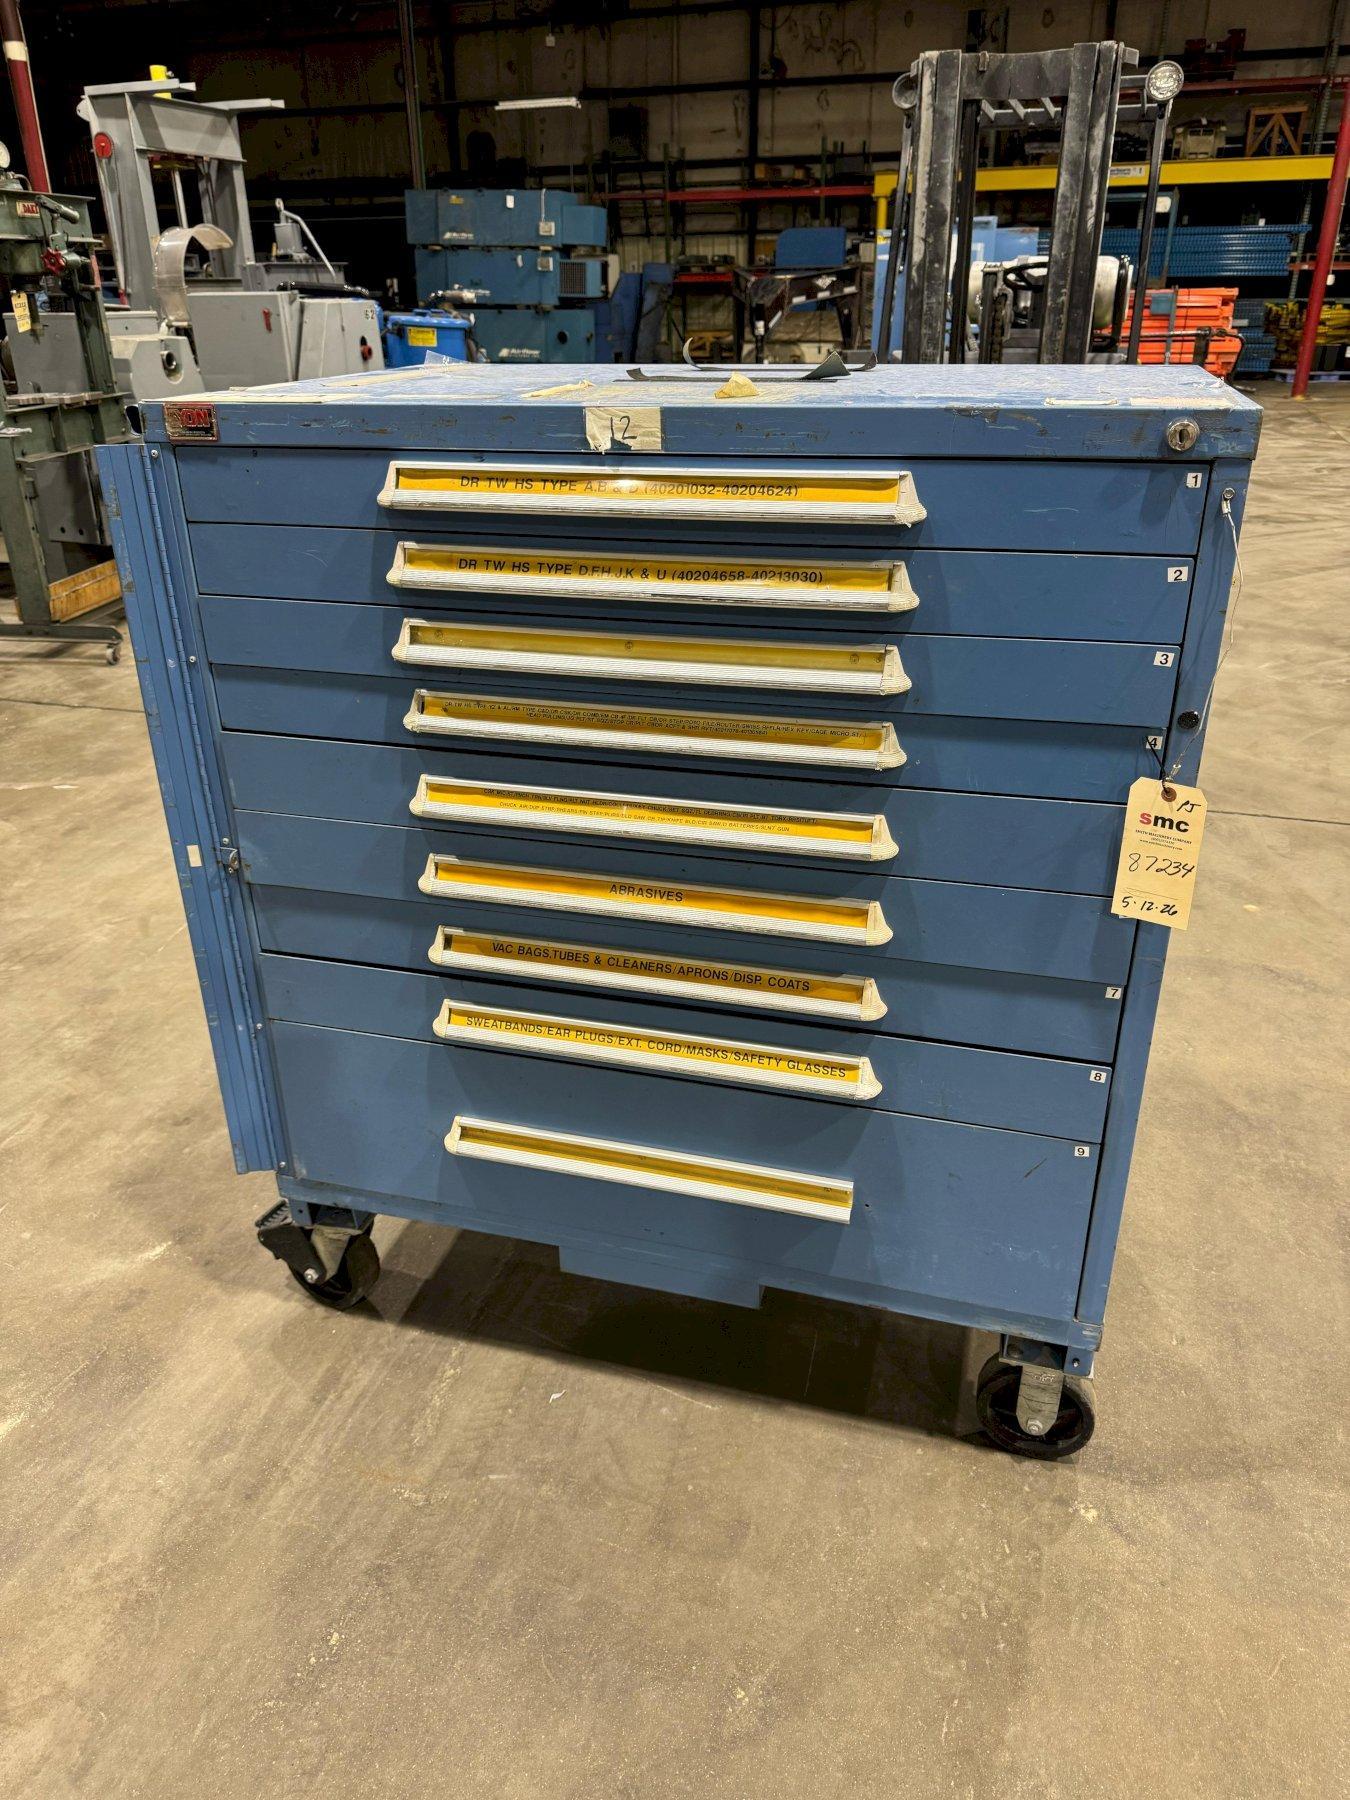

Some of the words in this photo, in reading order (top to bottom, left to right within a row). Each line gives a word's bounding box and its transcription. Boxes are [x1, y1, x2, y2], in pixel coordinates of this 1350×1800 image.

[610, 416, 638, 440] 12
[460, 476, 480, 488] DR
[487, 477, 509, 489] TW
[514, 478, 534, 490] HS
[541, 479, 578, 492] TYPE
[1192, 474, 1199, 486] 1
[458, 558, 478, 570] DR
[484, 560, 506, 572] TW
[512, 561, 530, 573] HS
[537, 562, 573, 575] TYPE
[640, 568, 650, 580] &
[656, 570, 667, 580] U
[672, 570, 824, 584] (40204658-40213030)
[1173, 570, 1184, 581] 2
[1159, 654, 1169, 665] 3
[1148, 737, 1158, 748] 4
[1139, 812, 1190, 833] smc
[1128, 852, 1196, 878] 87234
[609, 884, 684, 902] ABRASIVES
[492, 942, 514, 954] VAC
[594, 955, 602, 965] &
[768, 976, 810, 992] COATS
[1111, 988, 1120, 998] 7
[466, 1016, 571, 1038] SWEATBANDS/EAR
[648, 1040, 782, 1068] CORD/MASKS/SAFETY
[786, 1059, 846, 1078] GLASSES
[1094, 1072, 1102, 1082] 8
[1077, 1148, 1085, 1156] 9
